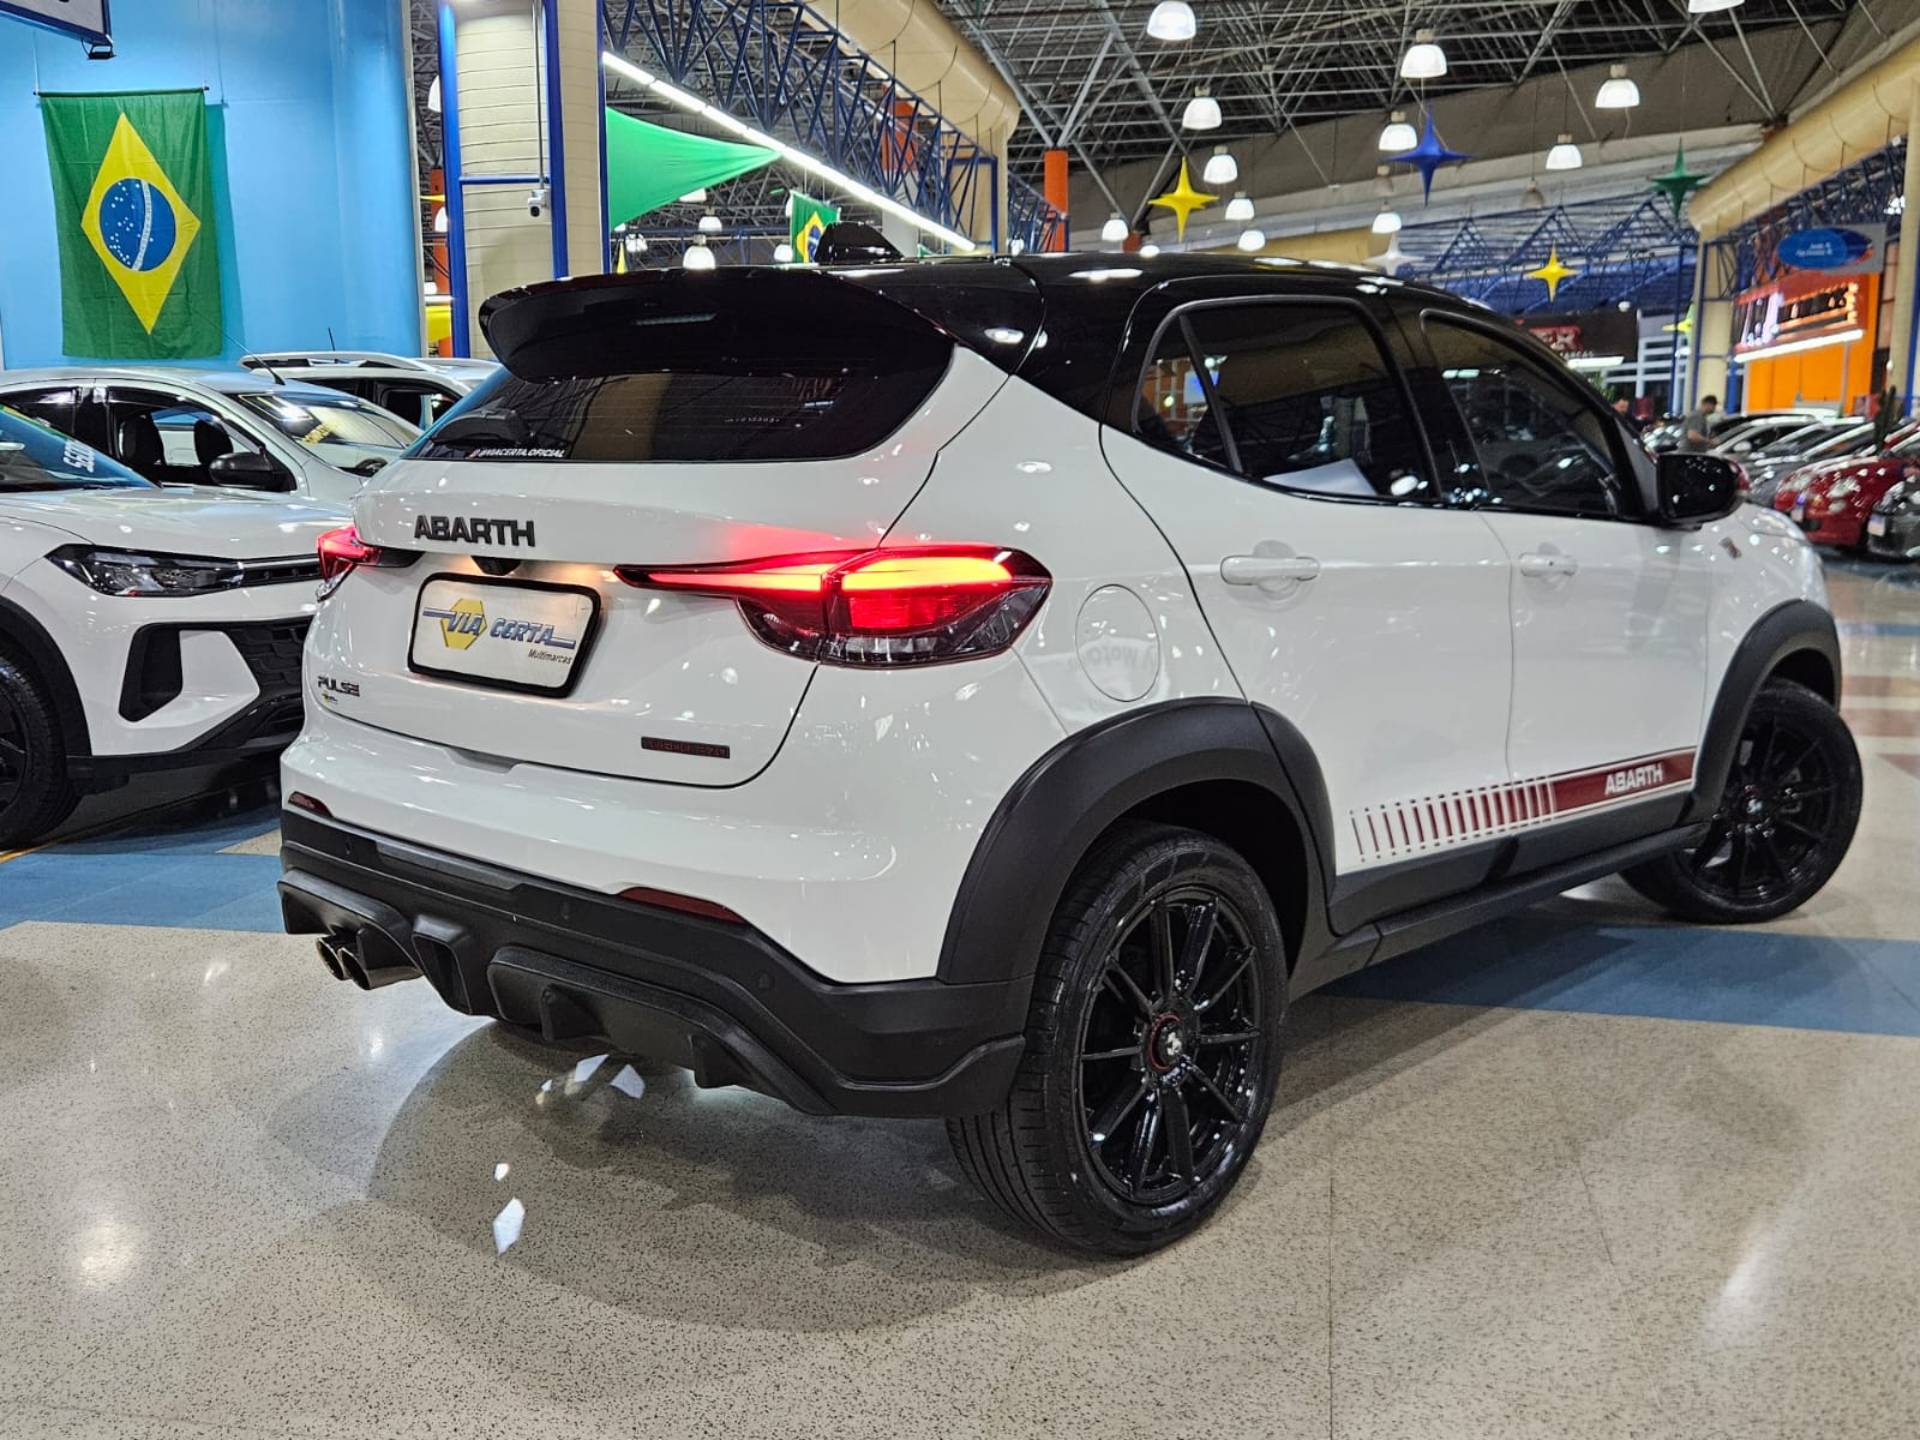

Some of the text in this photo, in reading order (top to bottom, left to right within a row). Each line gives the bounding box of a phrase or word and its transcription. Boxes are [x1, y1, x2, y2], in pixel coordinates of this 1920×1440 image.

[413, 514, 536, 548] ABARTH
[446, 611, 555, 646] VIA CERTA
[527, 648, 573, 665] Multimarcas
[317, 675, 361, 698] PULSE
[1604, 761, 1664, 796] ABARTH
